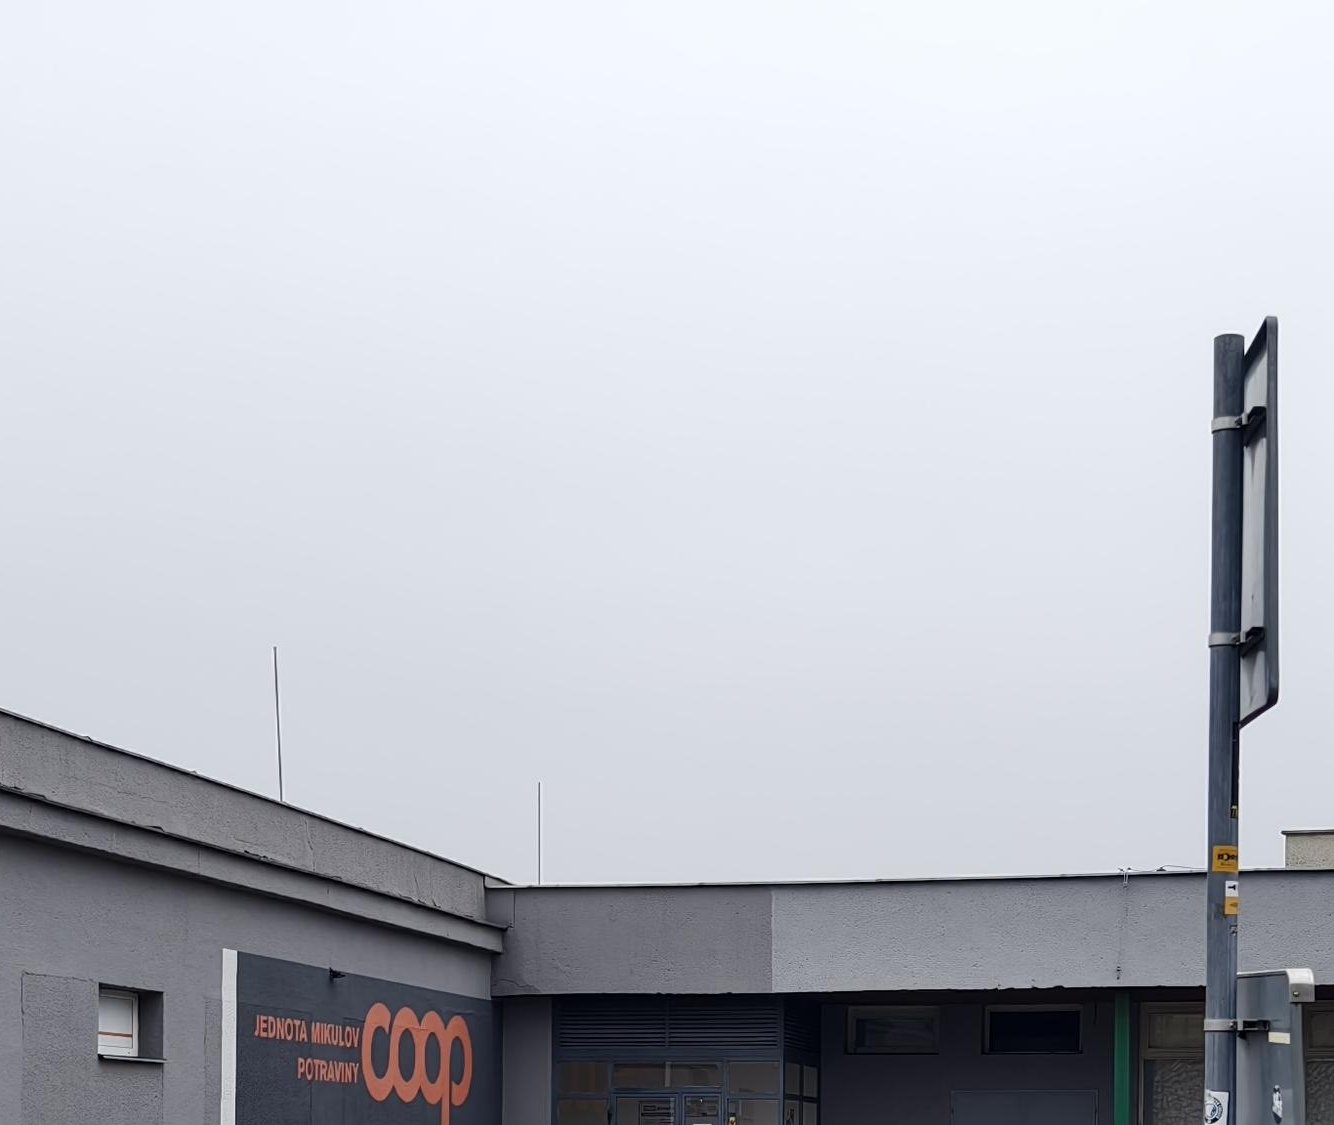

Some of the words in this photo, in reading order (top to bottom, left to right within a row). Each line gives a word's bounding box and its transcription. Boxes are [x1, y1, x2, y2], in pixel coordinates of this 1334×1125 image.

[255, 1014, 307, 1042] JEDNOTA
[311, 1022, 360, 1048] MIKULOV
[297, 1057, 359, 1083] POTRAVINY
